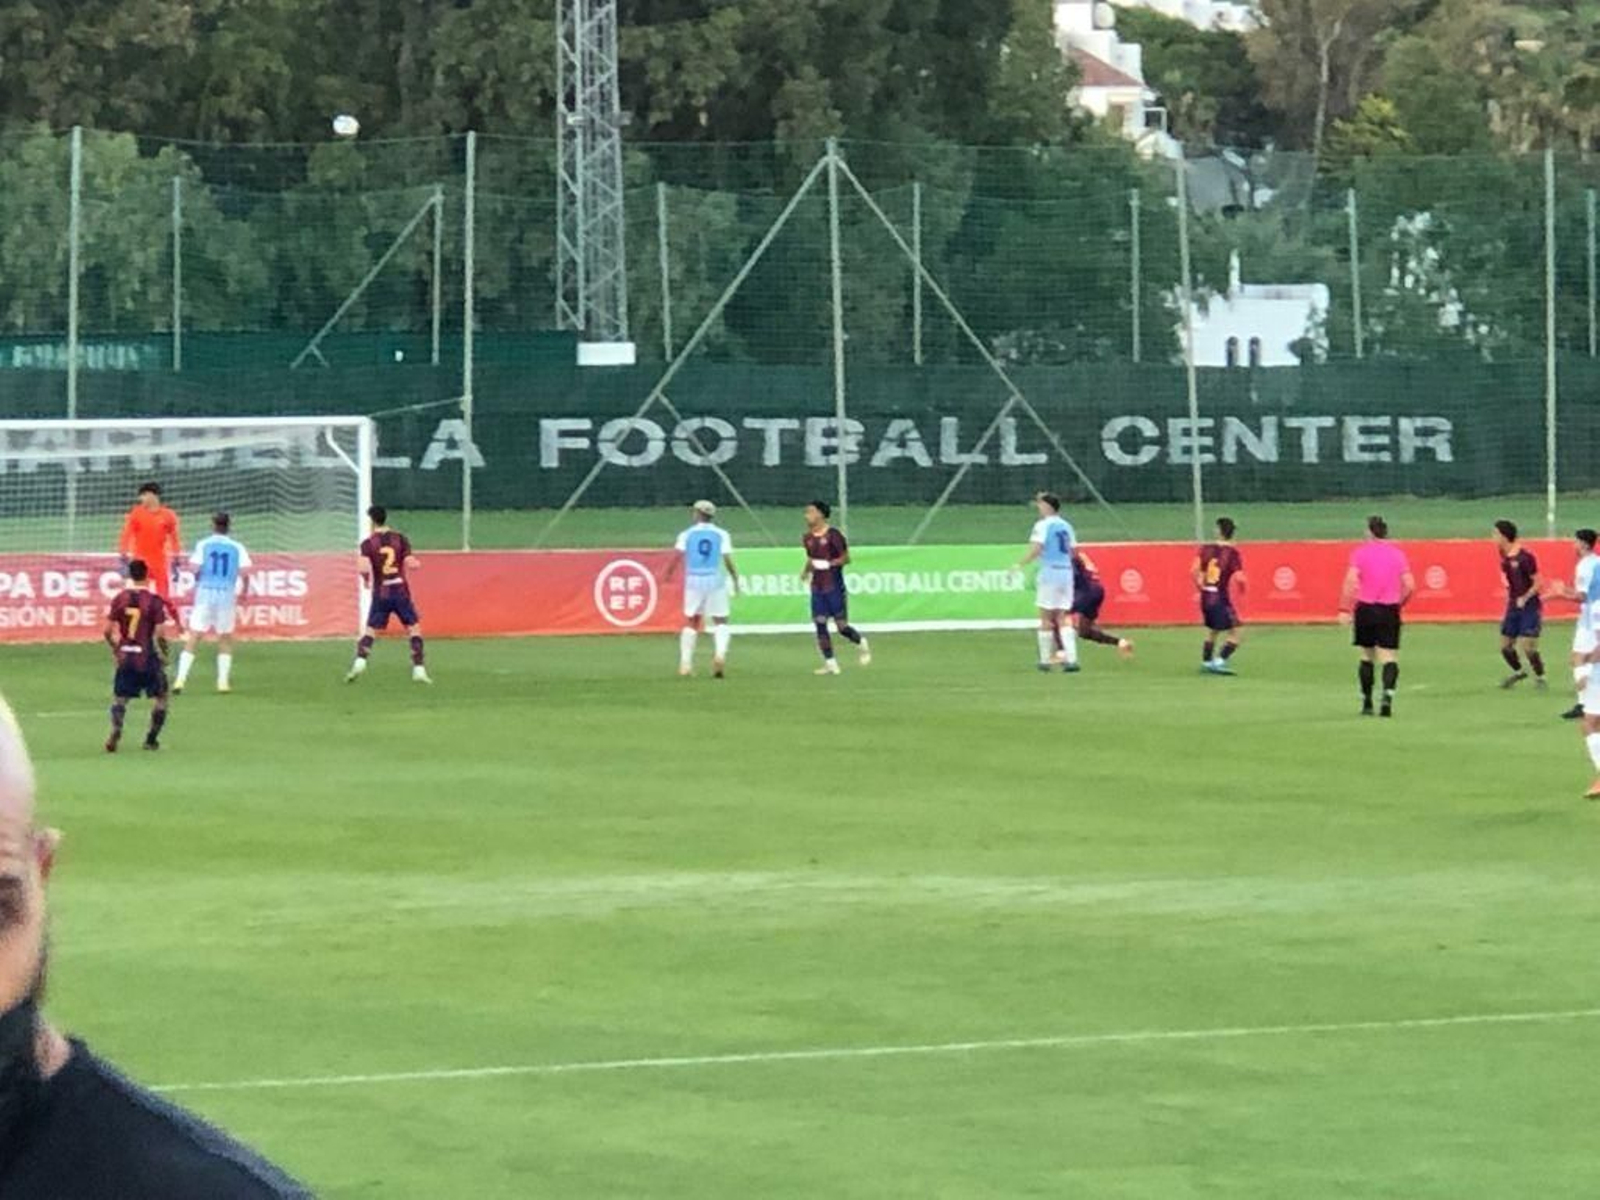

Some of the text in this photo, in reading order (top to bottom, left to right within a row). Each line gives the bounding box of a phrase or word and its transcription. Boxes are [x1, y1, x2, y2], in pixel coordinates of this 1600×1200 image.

[0, 414, 1456, 474] ARBELLA FOOTBALL CENTER
[209, 550, 229, 577] 11
[379, 546, 399, 574] 2
[697, 539, 713, 563] 9
[43, 571, 90, 598] DE
[843, 571, 943, 595] OOTBALL
[947, 569, 1026, 592] CENTER
[62, 604, 98, 627] DE
[124, 607, 141, 639] 7
